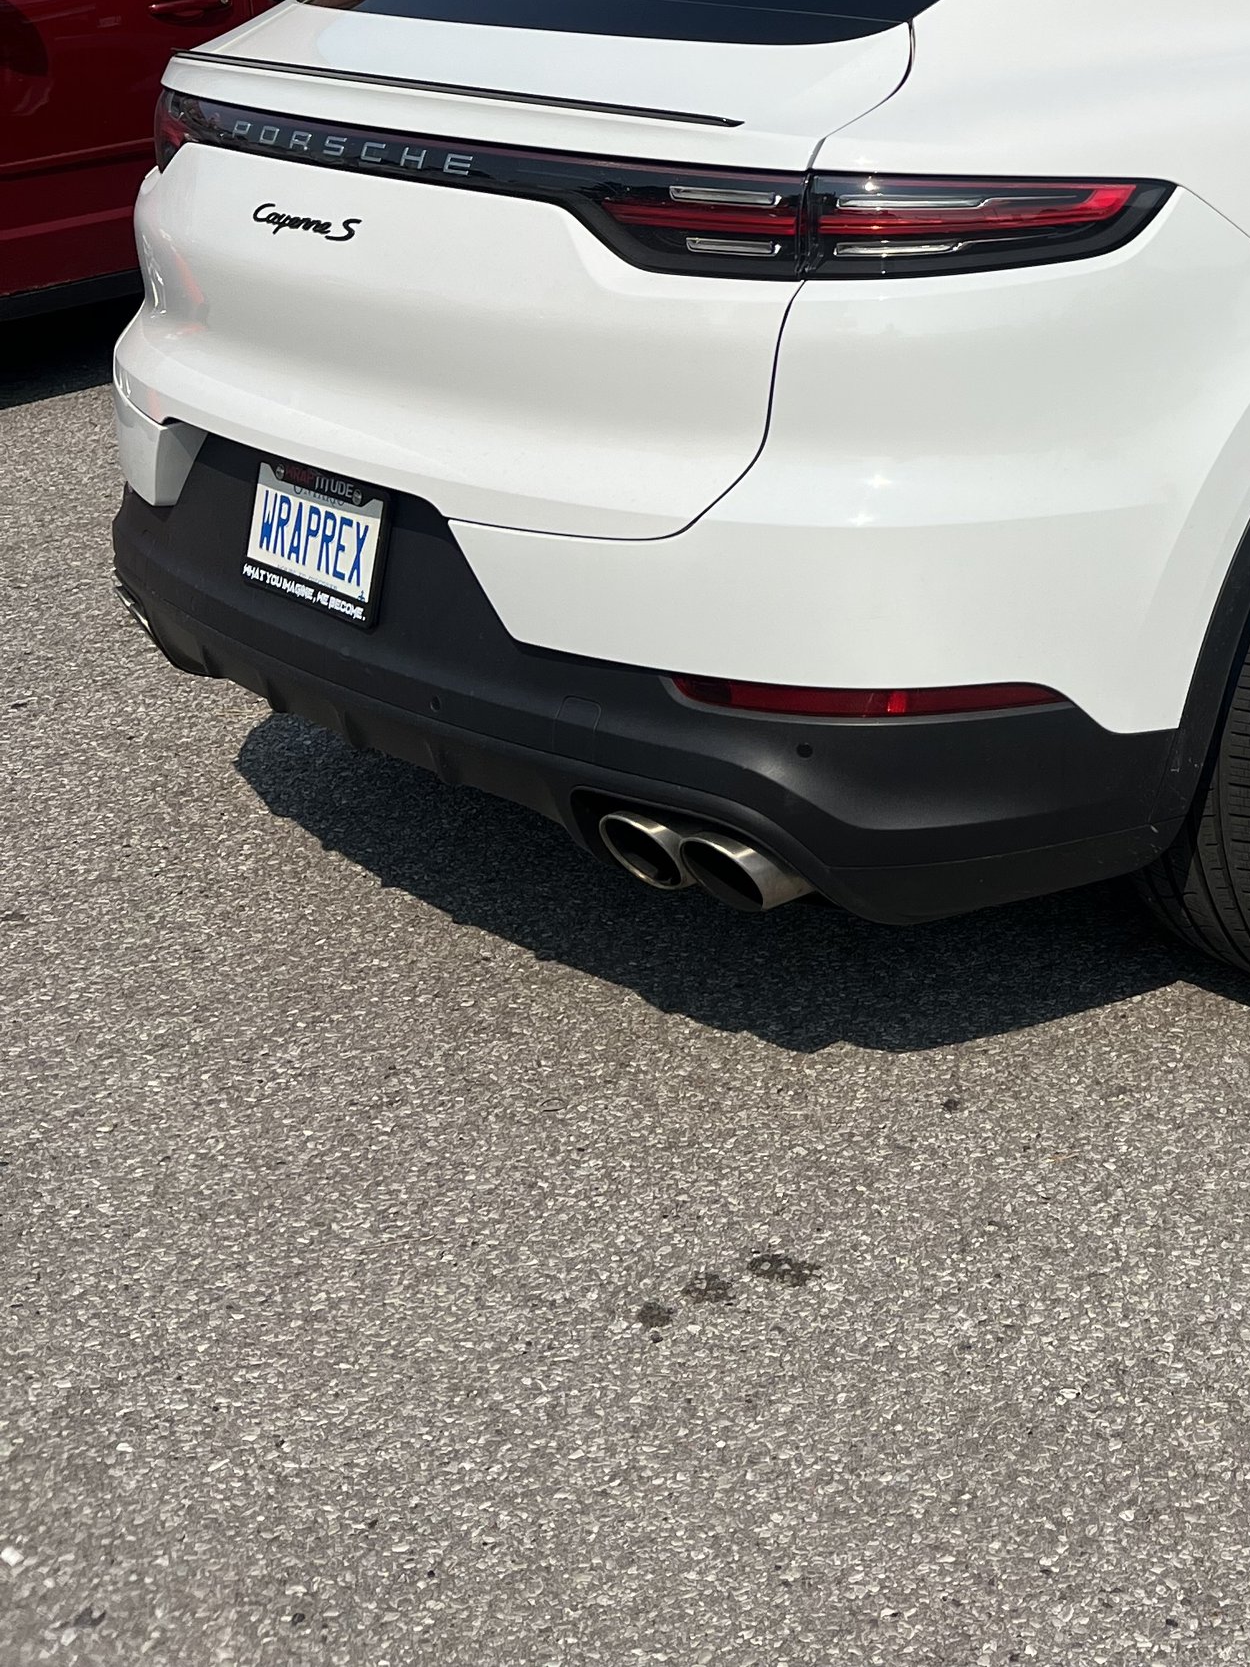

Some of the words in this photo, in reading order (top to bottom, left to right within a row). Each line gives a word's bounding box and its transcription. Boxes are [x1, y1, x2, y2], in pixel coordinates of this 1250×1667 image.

[232, 120, 473, 176] PORSCHE
[253, 203, 331, 235] Cayenne
[325, 218, 362, 241] S
[259, 489, 369, 587] WRAPREX
[242, 563, 267, 582] WHAT
[266, 572, 284, 589] YOU
